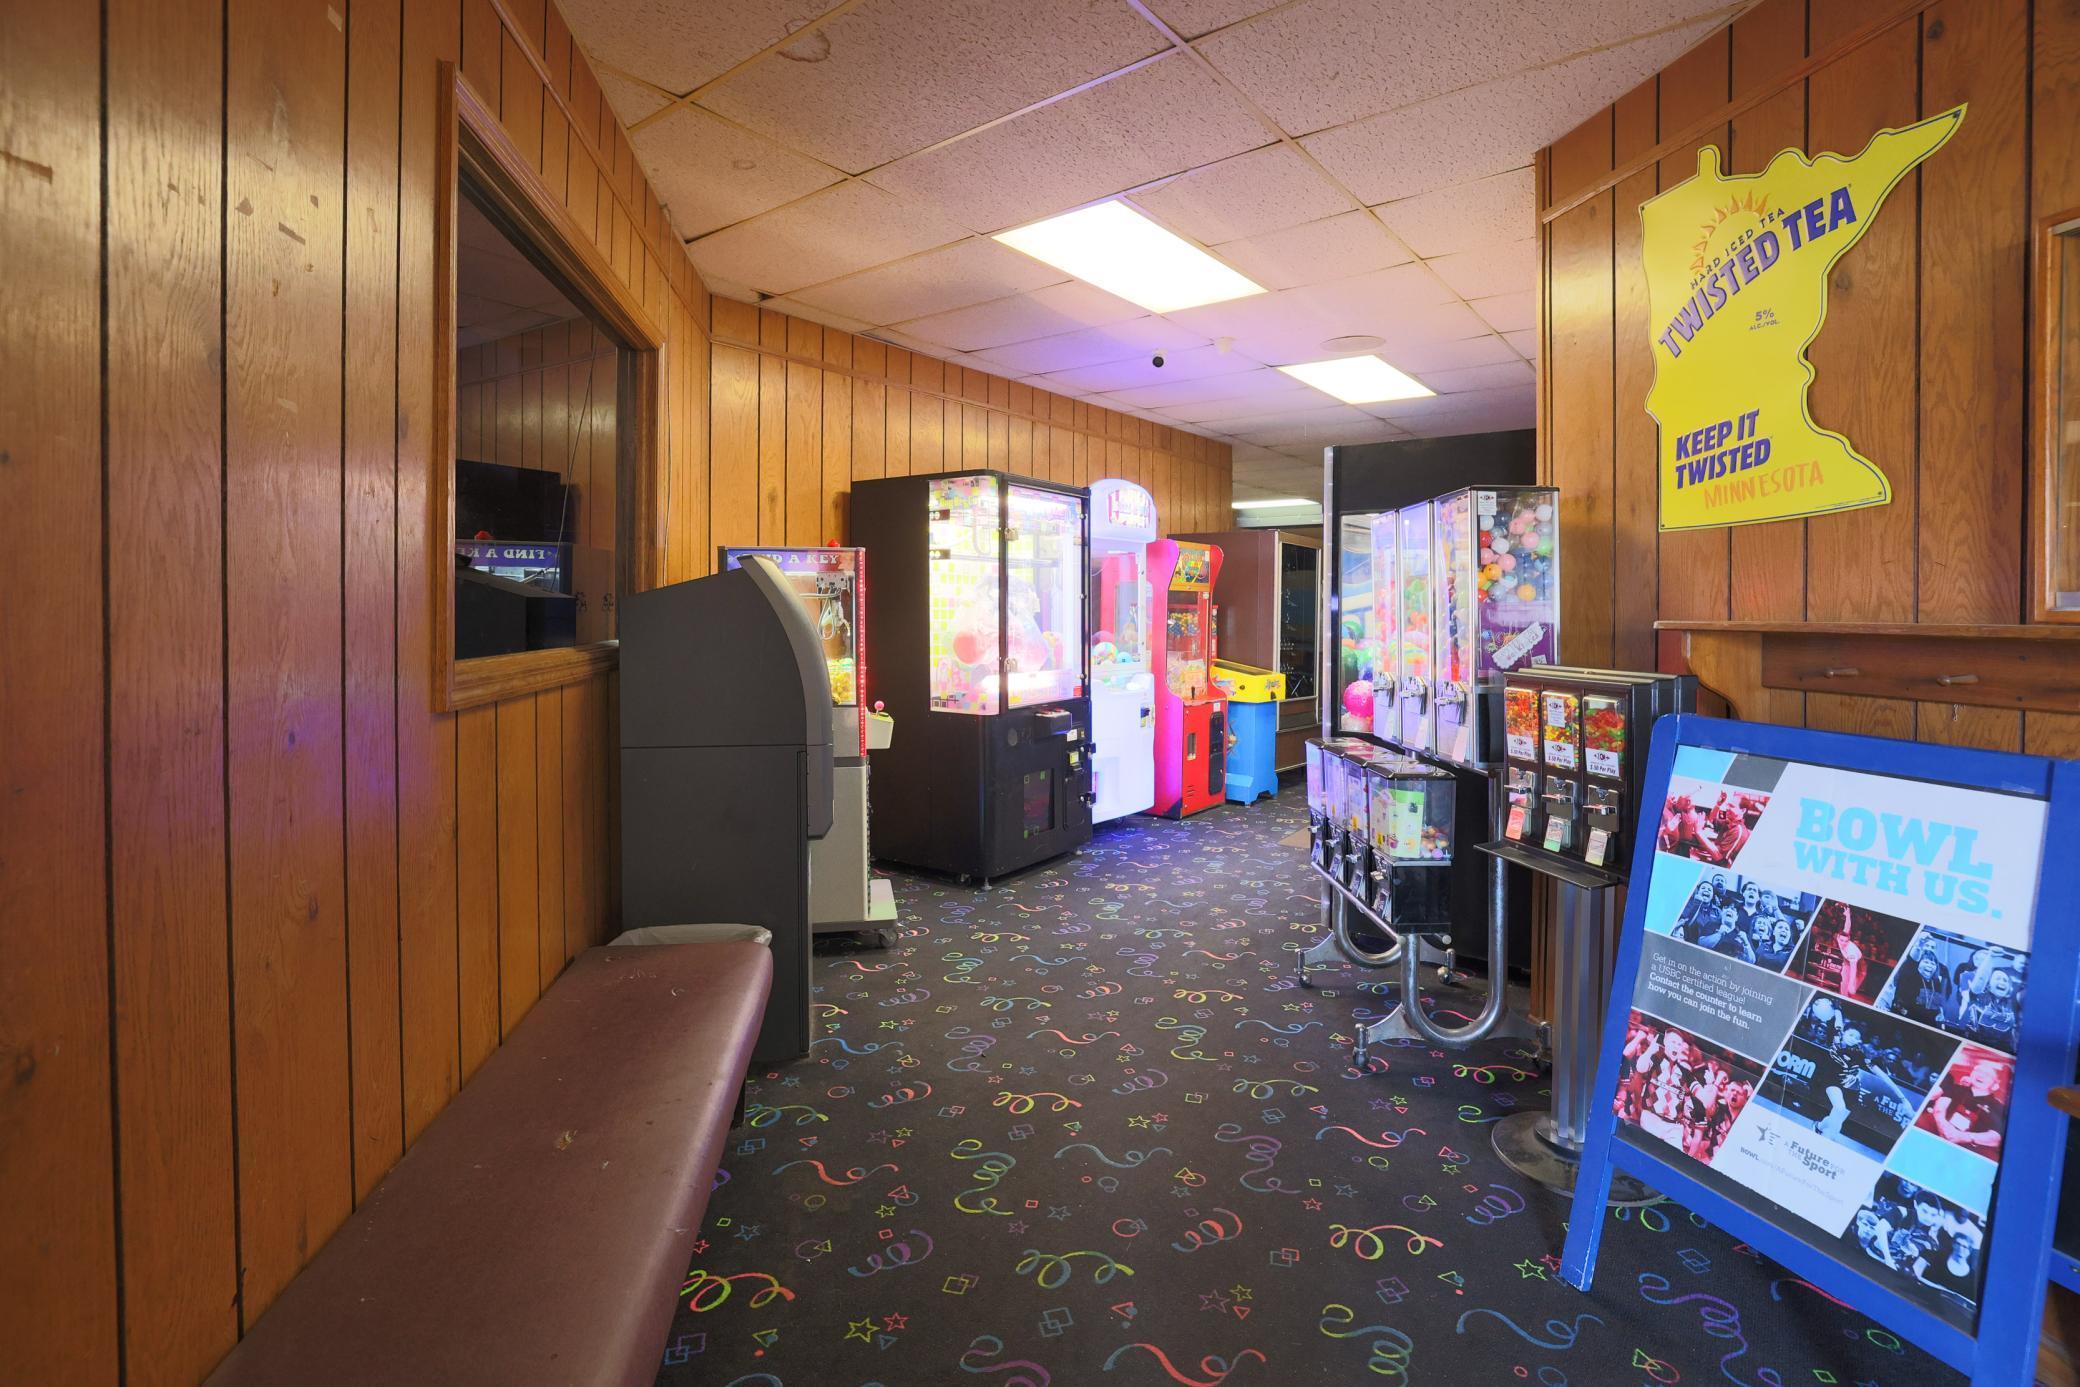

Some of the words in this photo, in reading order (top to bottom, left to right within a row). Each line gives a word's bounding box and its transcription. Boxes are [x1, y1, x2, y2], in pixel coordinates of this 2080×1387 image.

[1658, 230, 1780, 358] TWISTED
[1782, 186, 1857, 251] TEA
[1690, 257, 1721, 290] HARD
[1725, 229, 1754, 256] ICED
[1759, 208, 1786, 229] TEA
[1755, 307, 1775, 322] 5%
[1675, 419, 1733, 461] KEEP
[1737, 408, 1760, 442] IT
[1675, 437, 1771, 489] TWISTED
[1703, 460, 1825, 510] MINNESOTA
[790, 554, 800, 564] A
[809, 553, 840, 564] KEY
[1796, 797, 1994, 880] BOWL
[1793, 840, 1911, 896] WITH
[1923, 870, 2003, 920] US.
[1649, 971, 1680, 990] Contact
[1681, 983, 1694, 995] the
[1695, 991, 1728, 1009] counter
[1728, 1003, 1737, 1013] to
[1738, 1006, 1762, 1023] learn
[1651, 963, 1657, 971] a
[1658, 964, 1682, 980] USBC
[1682, 974, 1714, 993] certified
[1716, 985, 1746, 1005] league!
[1653, 952, 1667, 963] Get
[1668, 958, 1676, 967] in
[1678, 963, 1688, 972] on
[1689, 965, 1702, 977] the
[1703, 971, 1727, 987] action
[1729, 980, 1741, 993] by
[1741, 985, 1774, 1005] joining
[1648, 981, 1666, 995] how
[1667, 989, 1682, 1002] you
[1683, 997, 1698, 1008] can
[1699, 1002, 1716, 1016] join
[1717, 1009, 1731, 1021] the
[1732, 1015, 1750, 1030] fun.
[1790, 1140, 1830, 1167] Future
[1802, 1156, 1837, 1180] Sport
